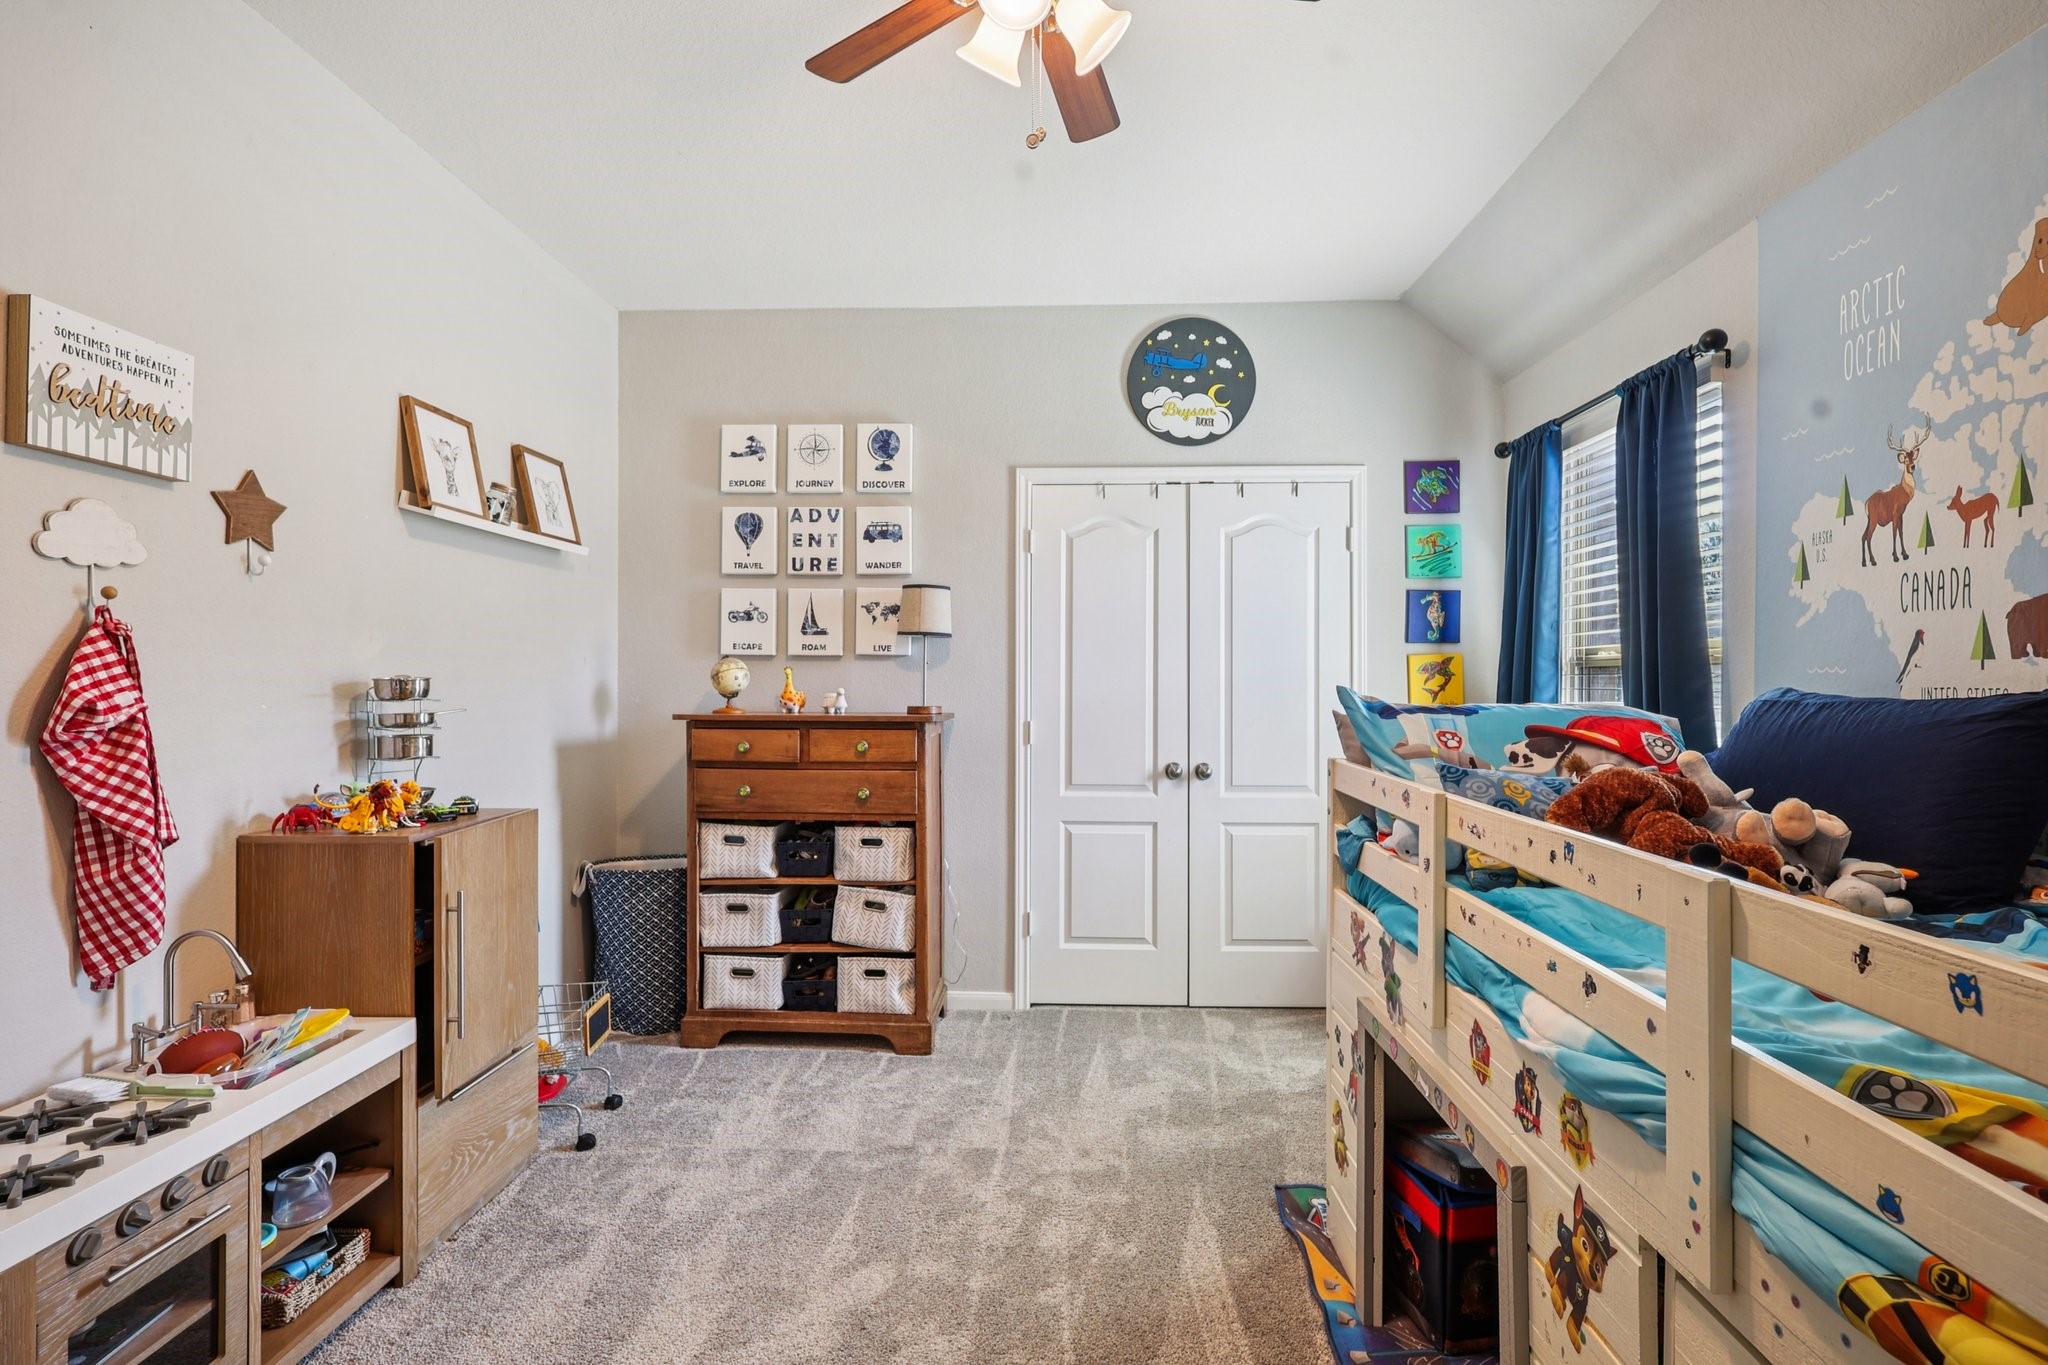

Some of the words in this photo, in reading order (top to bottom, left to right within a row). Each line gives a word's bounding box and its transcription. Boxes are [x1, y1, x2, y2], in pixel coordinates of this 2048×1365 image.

[1839, 265, 1906, 336] ARCTIC
[54, 325, 111, 354] SOMETIMES
[115, 346, 132, 361] THE
[135, 354, 178, 377] GREATEST
[1843, 319, 1901, 381] OCEAN
[61, 342, 123, 372] ADVENTURES
[127, 366, 161, 385] HAPPEN
[164, 379, 175, 389] AT
[48, 362, 177, 436] bedtime
[728, 479, 767, 488] EXPLORE
[795, 479, 834, 489] JOURNEY
[862, 480, 906, 489] DISCOVER
[1811, 529, 1833, 546] ALASKA
[733, 561, 764, 570] TRAVEL
[865, 561, 902, 570] WANDER
[1900, 566, 1972, 613] CANADA
[732, 642, 763, 651] ESCAPE
[801, 643, 827, 651] ROAM
[873, 644, 893, 652] LIVE
